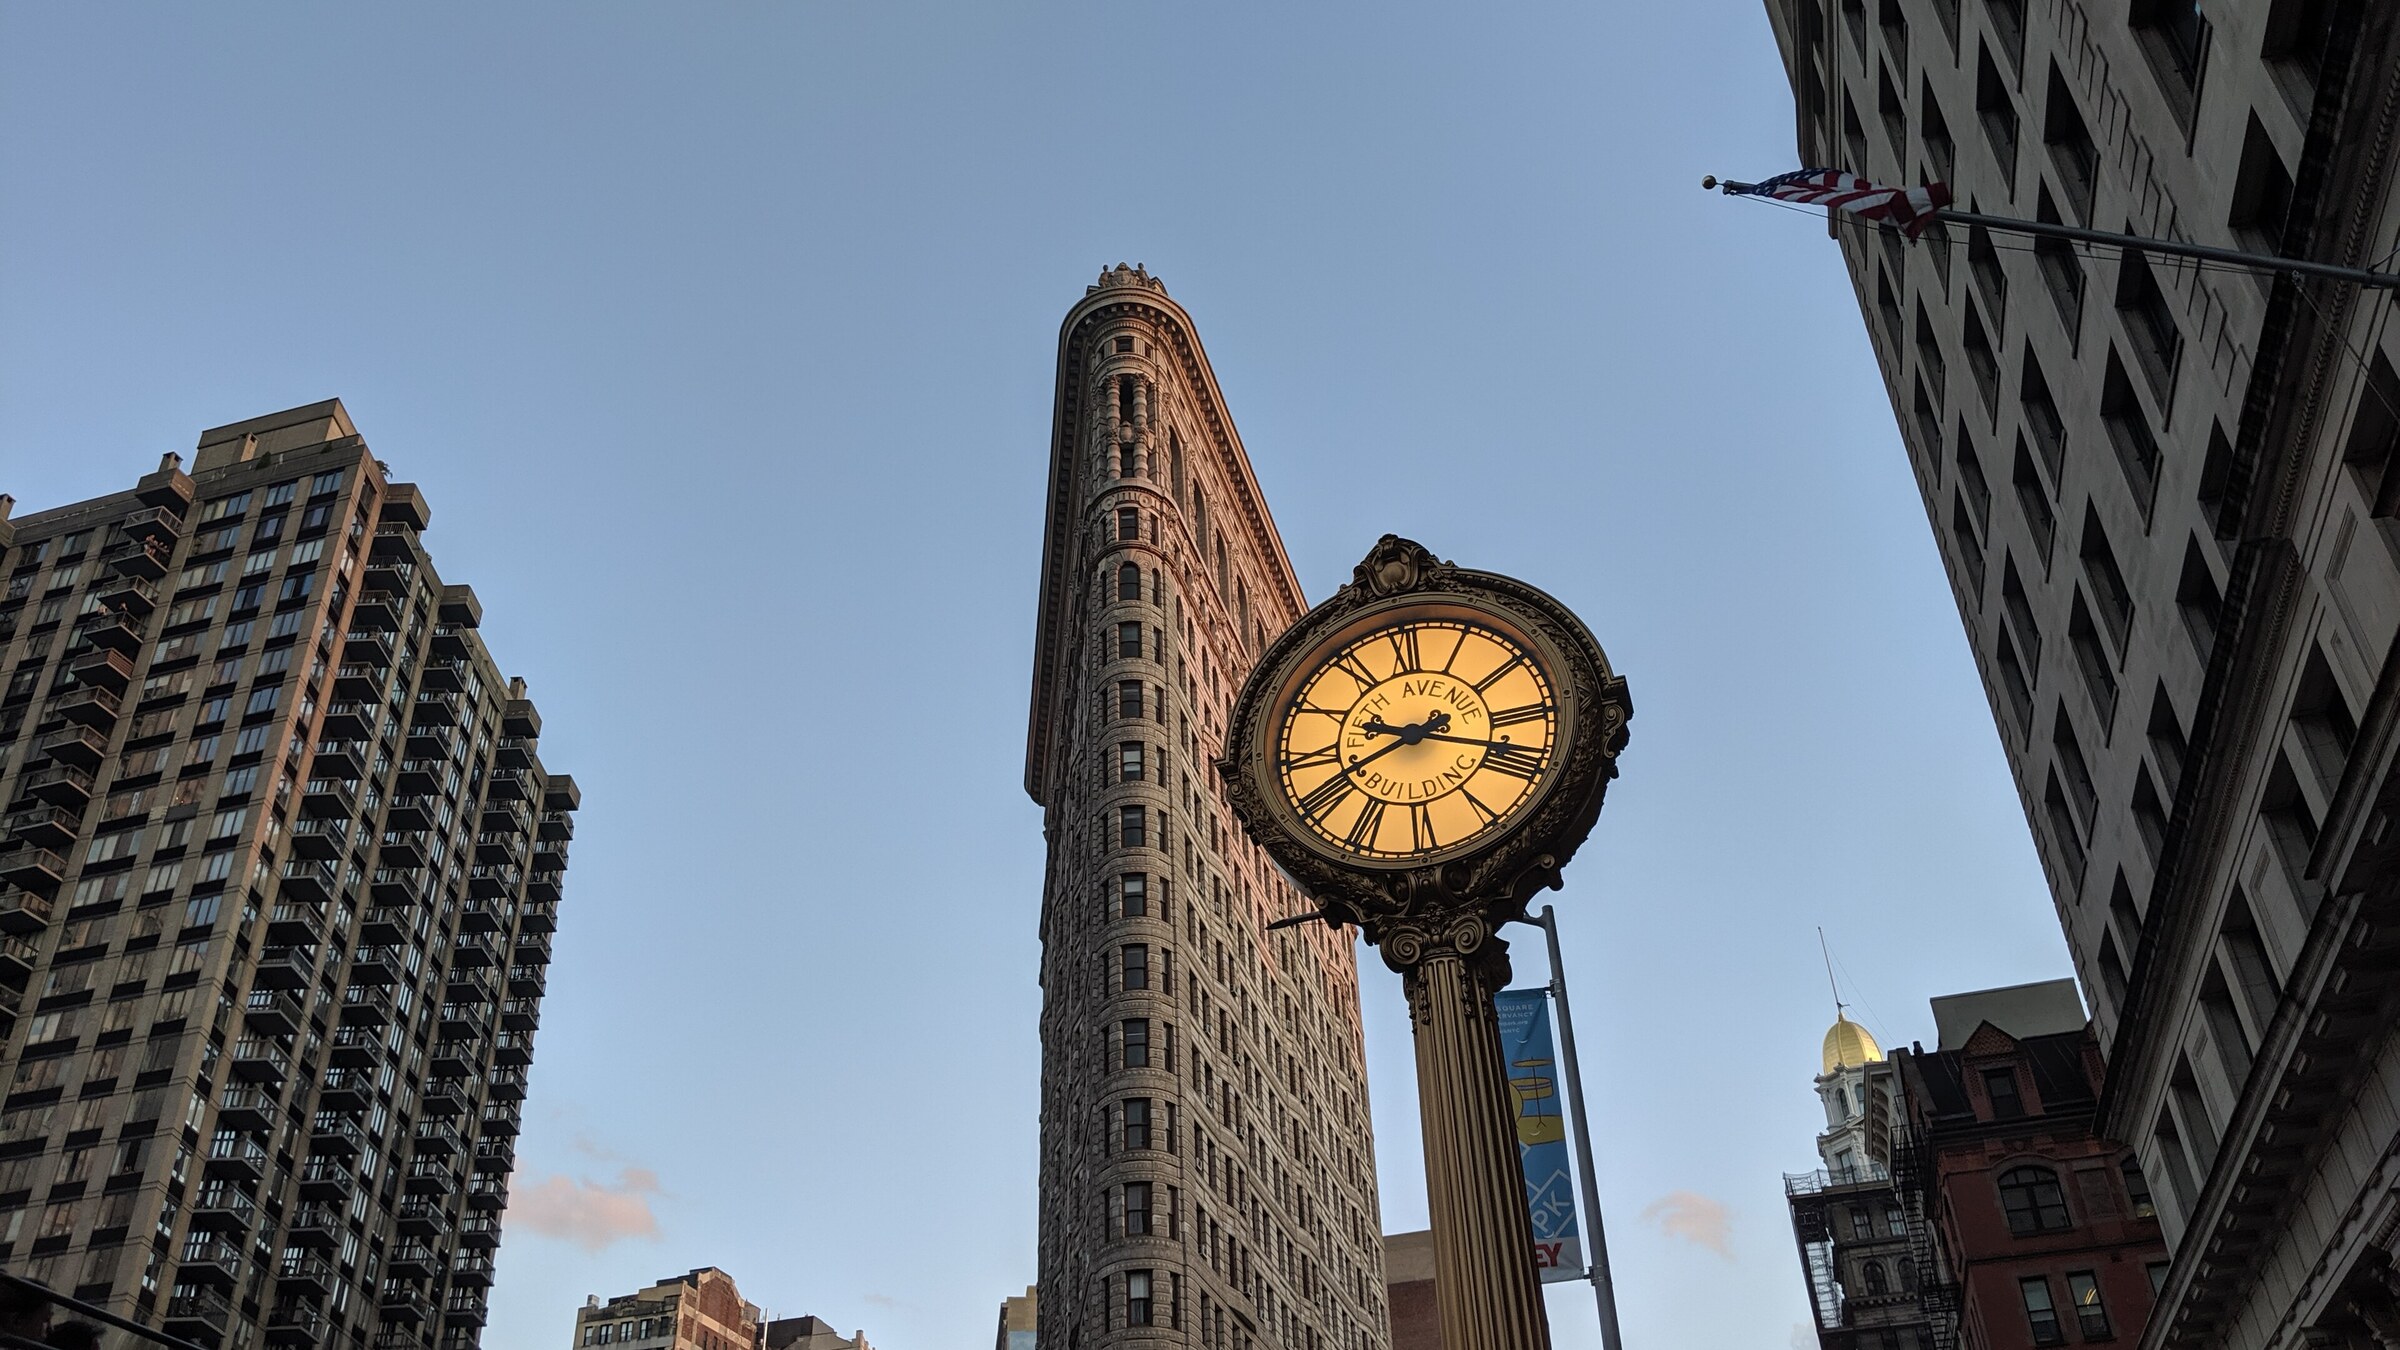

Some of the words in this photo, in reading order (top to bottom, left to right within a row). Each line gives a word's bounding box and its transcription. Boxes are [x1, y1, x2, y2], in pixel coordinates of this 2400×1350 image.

[1332, 652, 1380, 697] XI
[1388, 629, 1422, 677] XII
[1473, 655, 1524, 694] II
[1297, 697, 1350, 726] X
[1347, 693, 1391, 749] FIFTH
[1402, 680, 1482, 725] AVENUE
[1490, 700, 1547, 731] III
[1288, 741, 1340, 772] IX
[1364, 754, 1477, 800] BUILDING
[1346, 798, 1386, 851] VII
[1411, 804, 1438, 850] VI
[1459, 786, 1499, 828] V
[1531, 1190, 1571, 1233] PK
